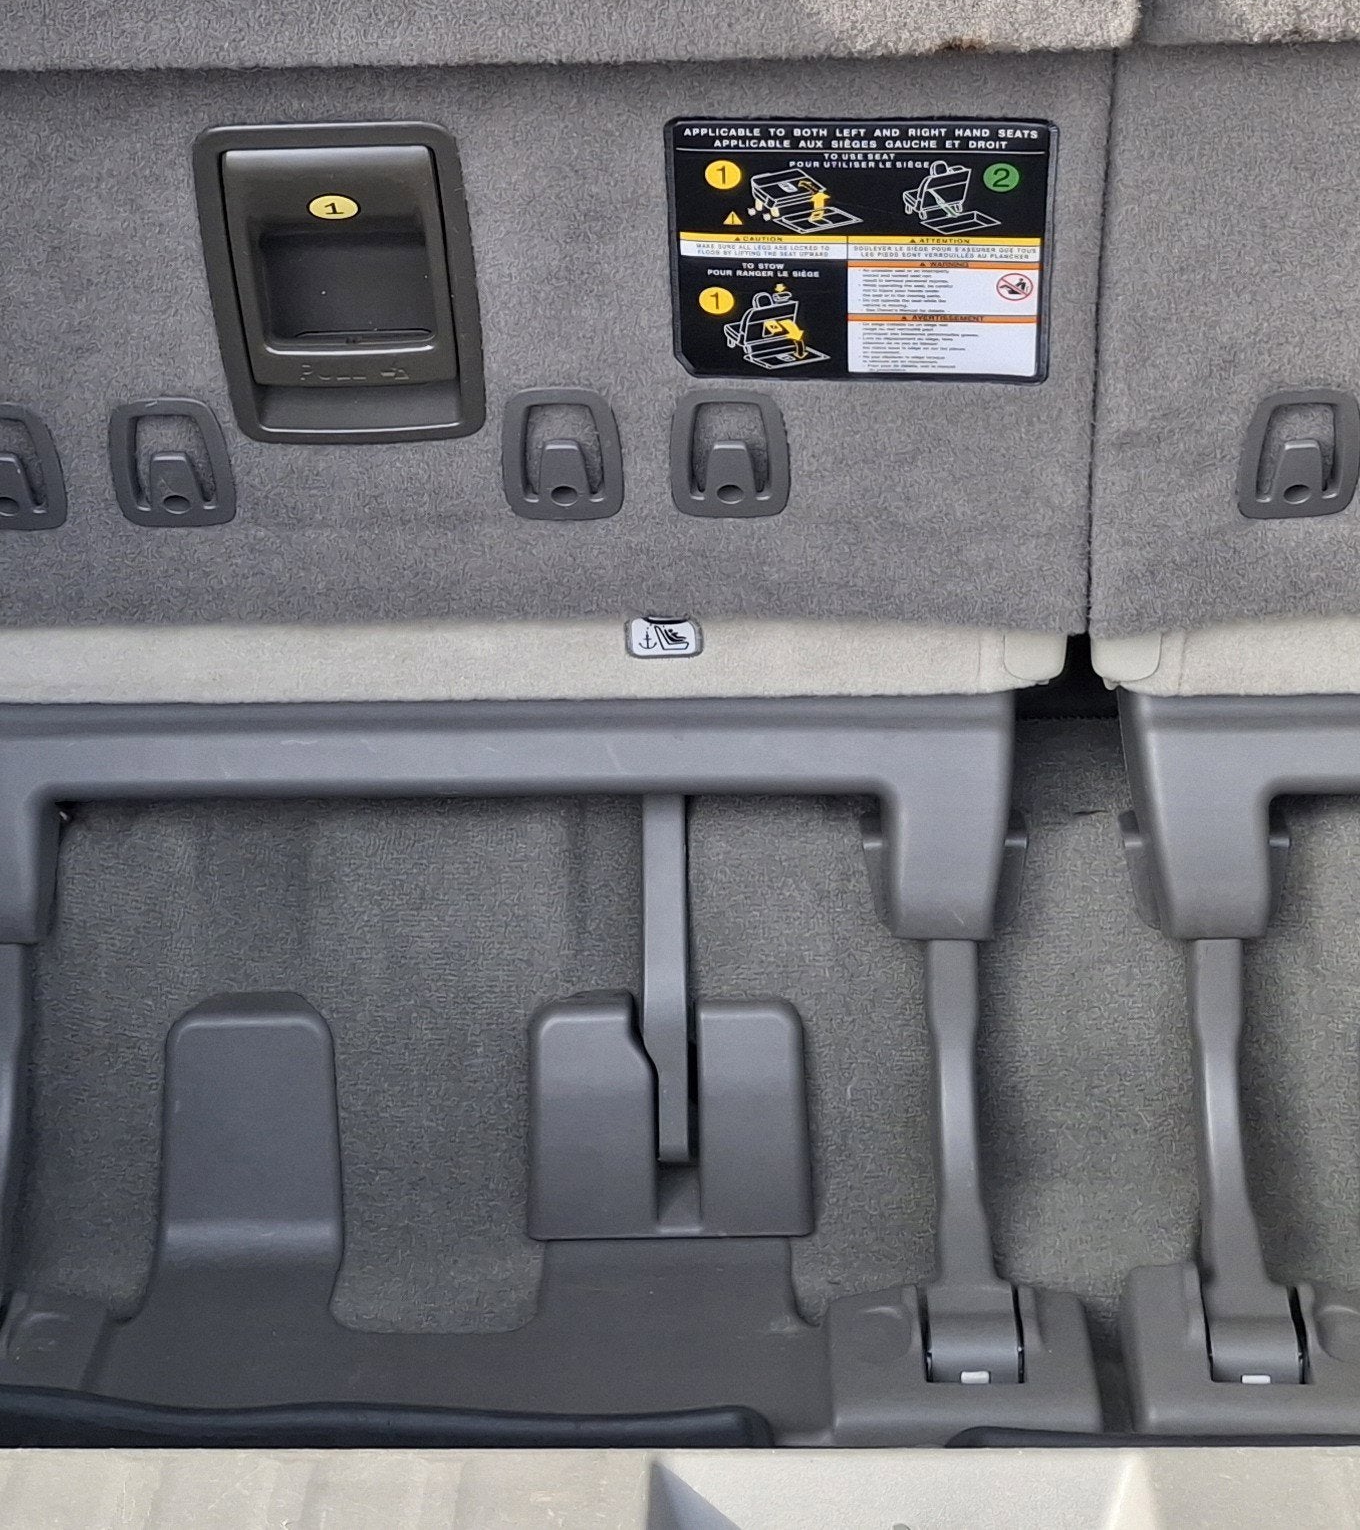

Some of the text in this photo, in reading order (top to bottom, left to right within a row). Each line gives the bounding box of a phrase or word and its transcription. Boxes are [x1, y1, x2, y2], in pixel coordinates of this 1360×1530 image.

[684, 128, 1038, 139] APPLICABLE TO BOTH LEFT AND RIGHT HAND SEATS
[714, 138, 1007, 149] APPLICABLE AUX SIÈGES GAUCHE ET DROIT
[896, 160, 930, 168] SIÈGE
[716, 166, 727, 184] 1
[992, 168, 1010, 188] 2
[324, 202, 344, 215] 1
[793, 269, 819, 277] SIÈGE
[711, 292, 720, 309] 1
